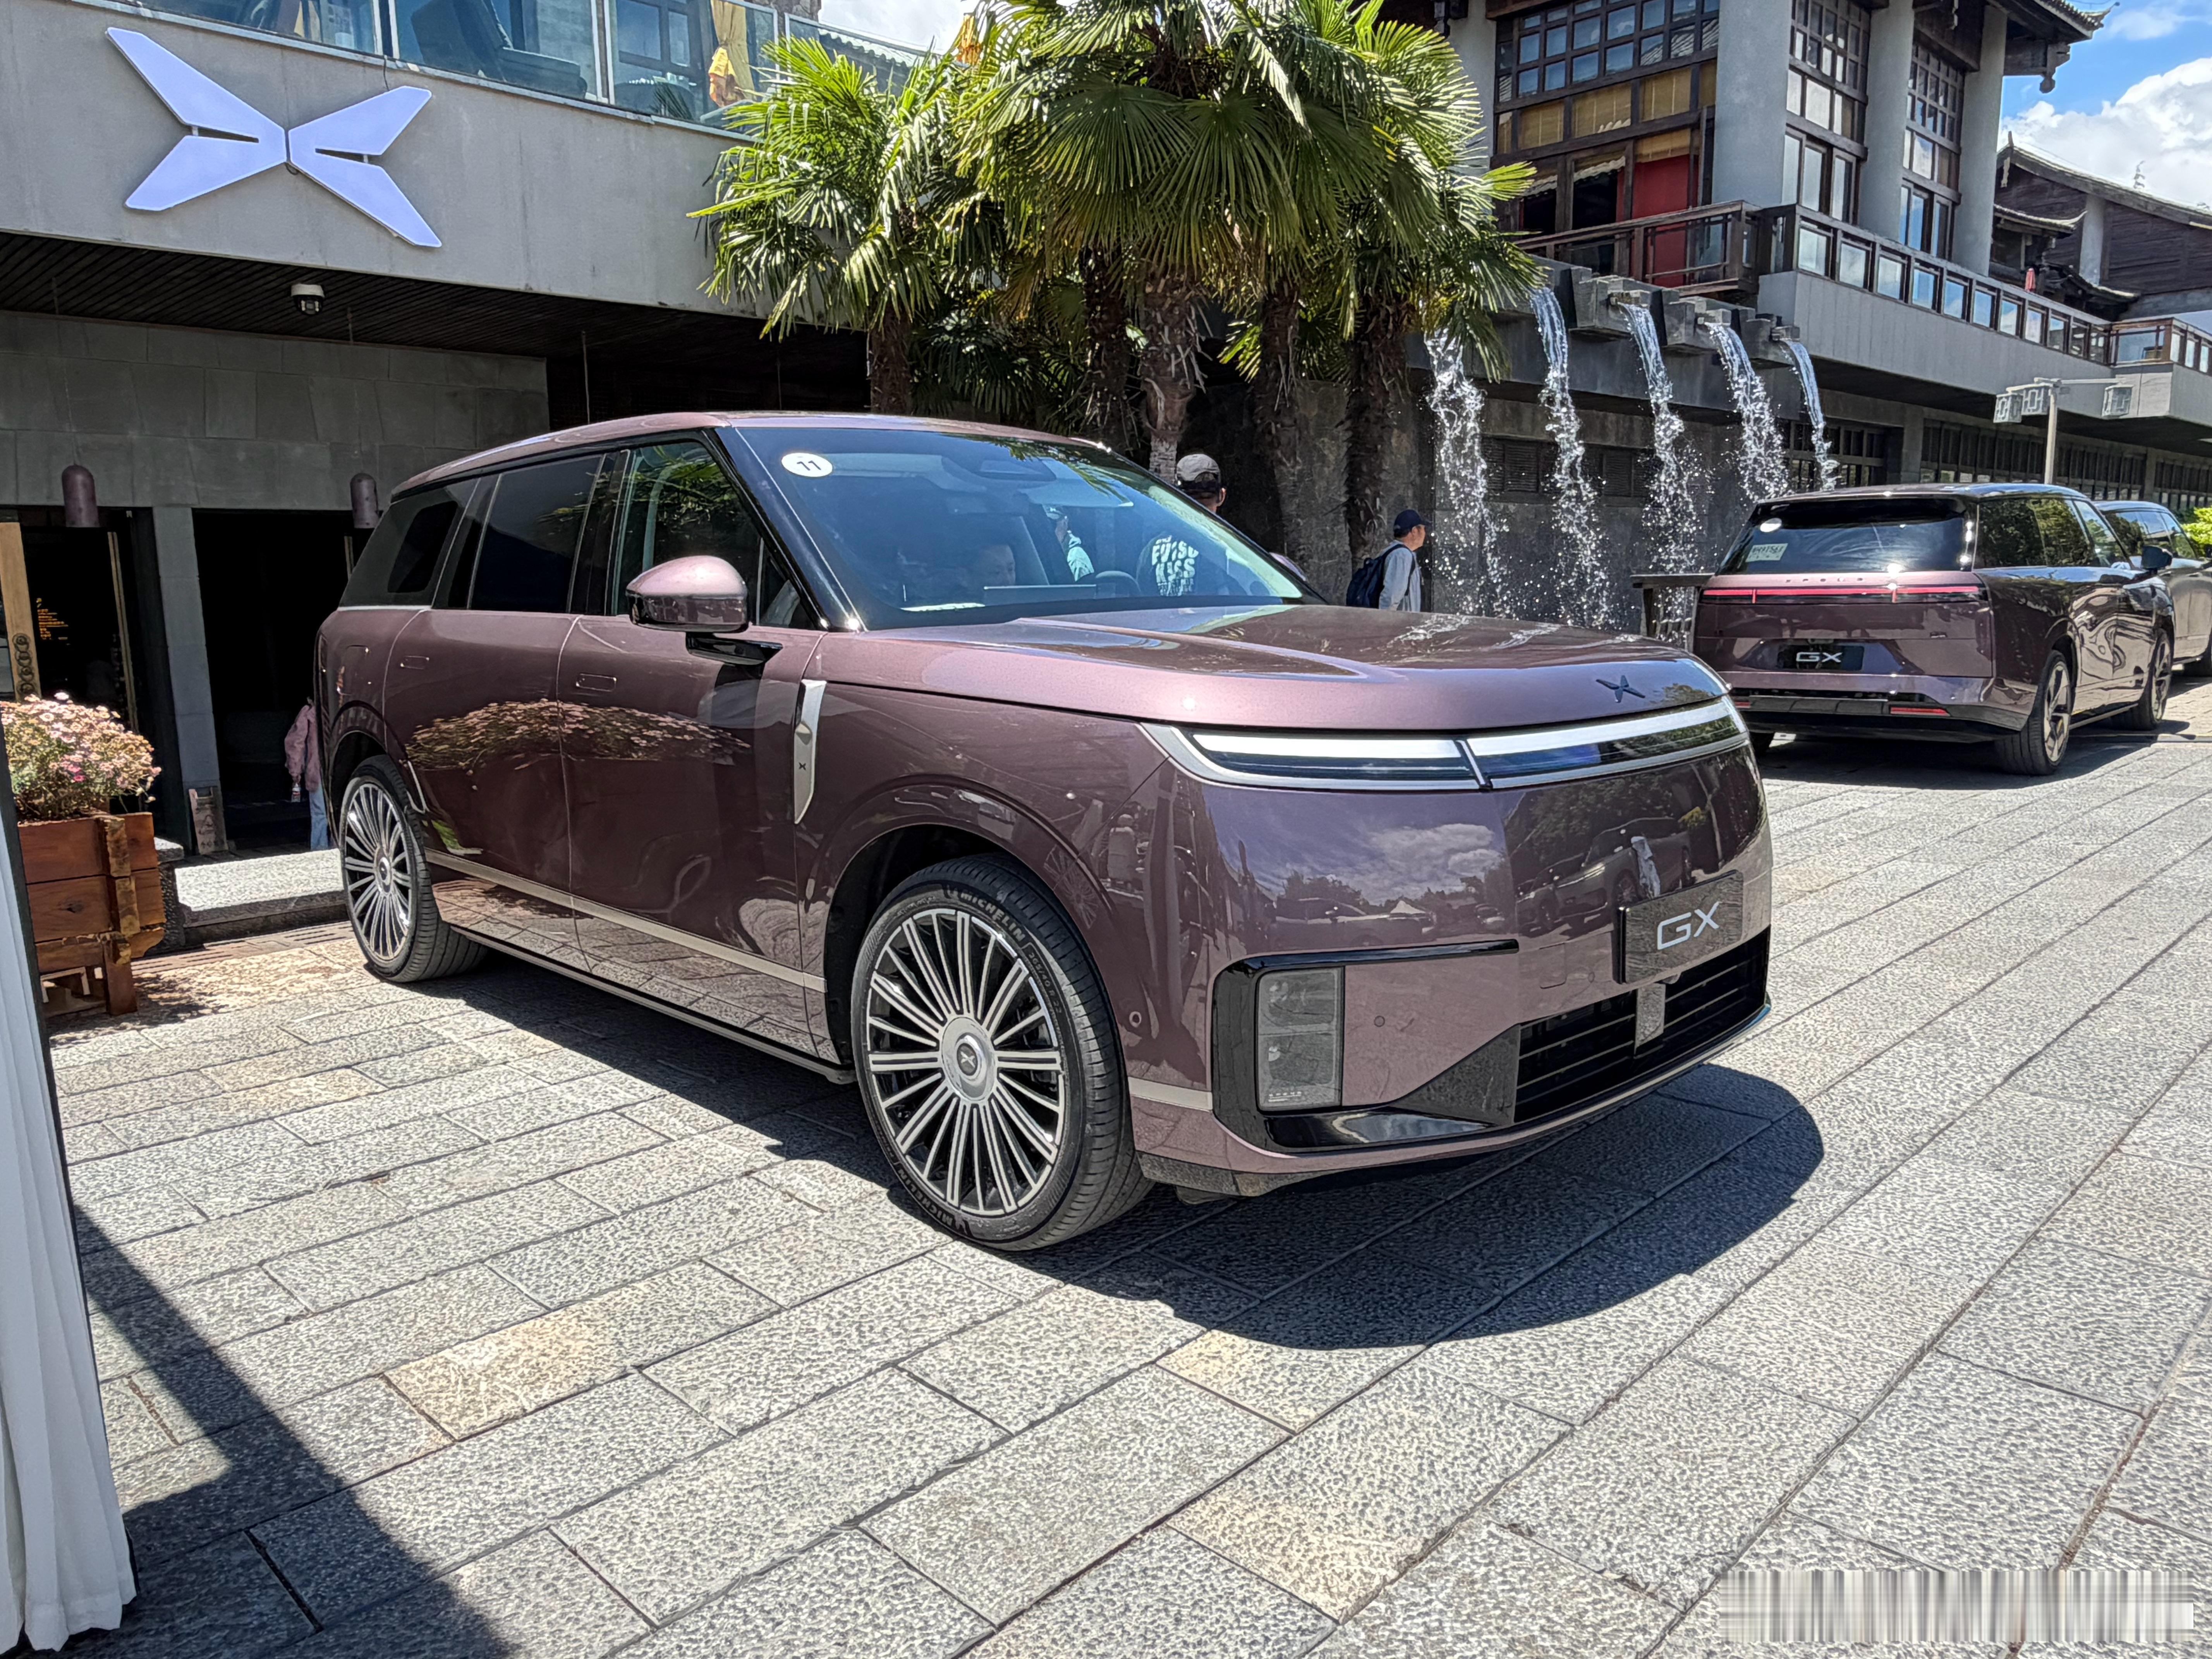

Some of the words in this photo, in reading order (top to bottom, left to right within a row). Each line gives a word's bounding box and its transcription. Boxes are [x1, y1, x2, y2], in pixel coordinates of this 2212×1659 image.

[796, 460, 822, 471] 11
[1796, 651, 1843, 663] GX
[961, 892, 1025, 941] MICHELIN
[1657, 901, 1721, 950] GX
[897, 1168, 953, 1226] MICHELIN
